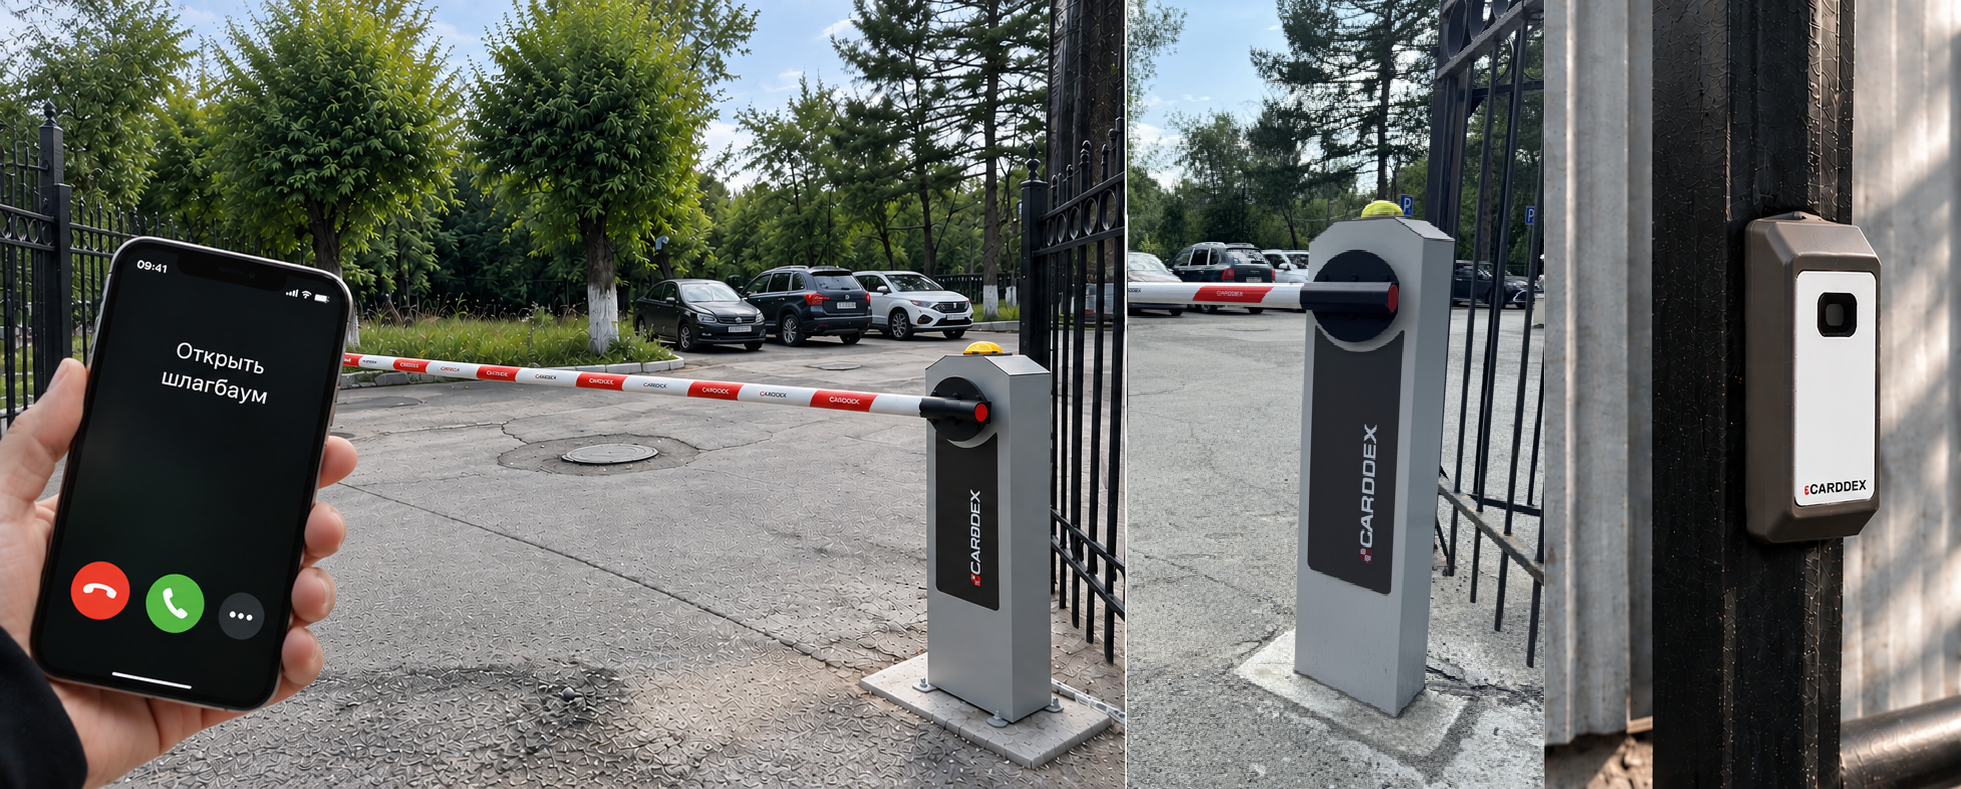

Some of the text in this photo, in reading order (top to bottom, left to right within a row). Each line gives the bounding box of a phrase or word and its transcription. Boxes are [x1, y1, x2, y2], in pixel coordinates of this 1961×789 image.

[1403, 197, 1411, 213] P
[136, 259, 168, 274] 09:41
[176, 342, 265, 375] Открыть
[161, 371, 268, 404] шлагбаум
[1360, 424, 1377, 548] CARDDEX
[1810, 480, 1867, 494] CARDDEX
